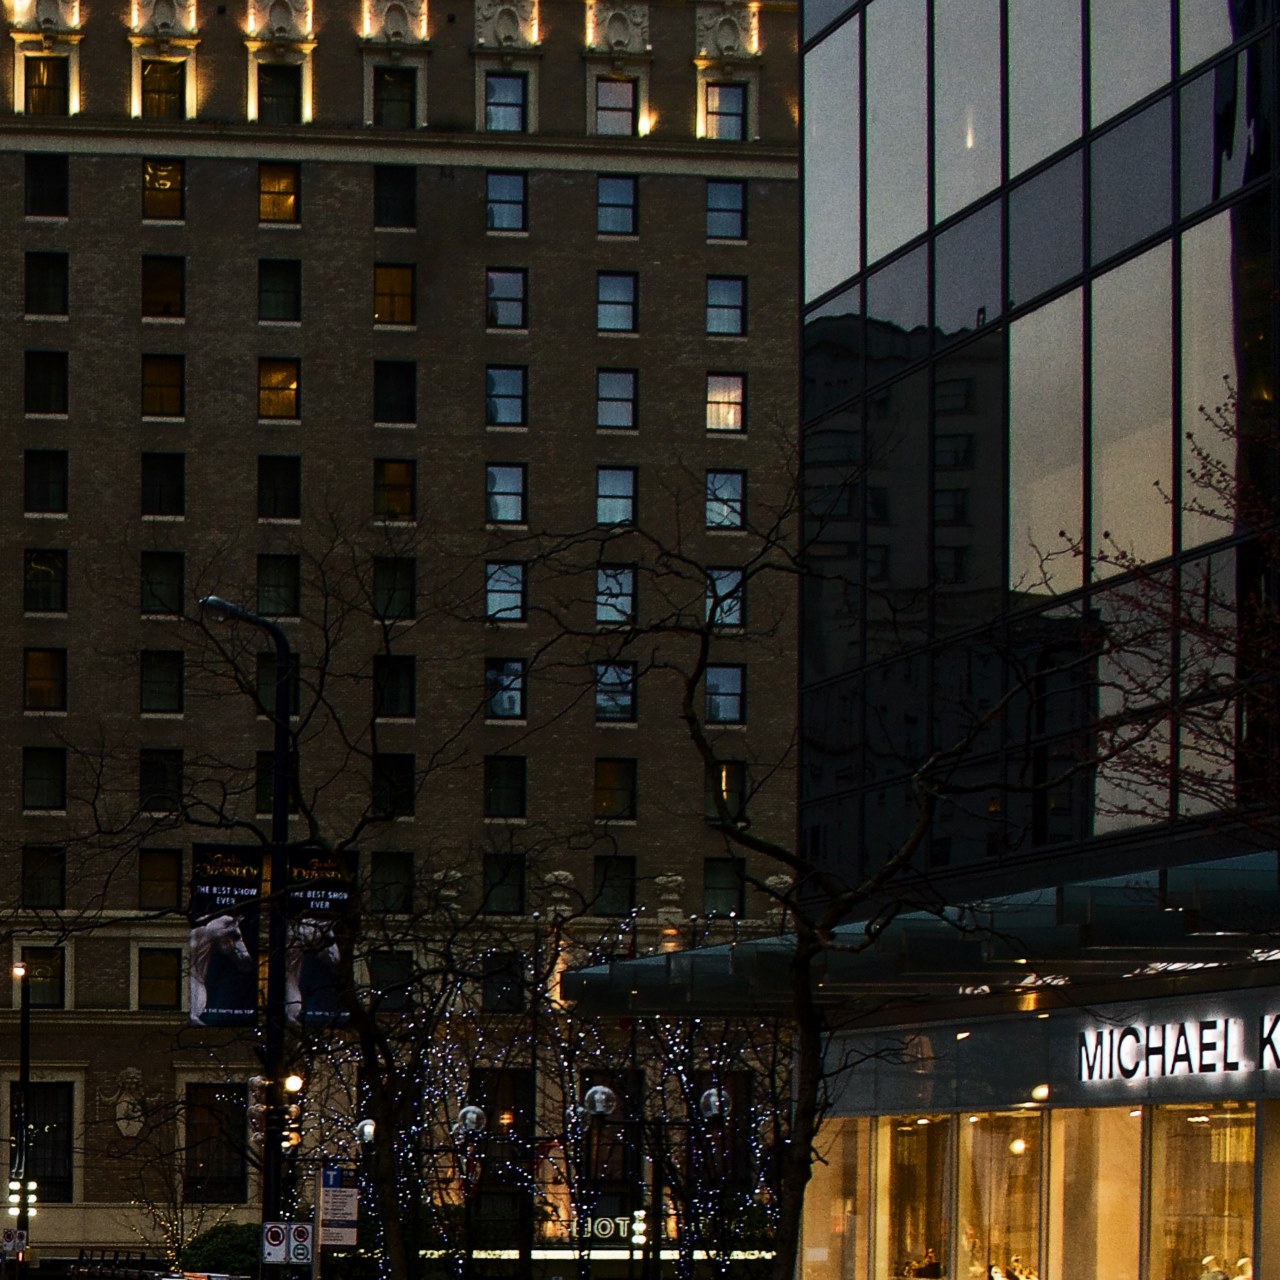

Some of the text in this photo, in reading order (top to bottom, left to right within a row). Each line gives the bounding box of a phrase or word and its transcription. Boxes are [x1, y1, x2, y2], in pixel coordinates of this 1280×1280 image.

[197, 885, 210, 894] THE
[212, 886, 231, 895] BEST
[307, 890, 326, 899] BEST
[216, 896, 236, 905] EVER
[310, 901, 331, 909] EVER
[1078, 1017, 1240, 1082] MICHAEL
[326, 1171, 337, 1186] T
